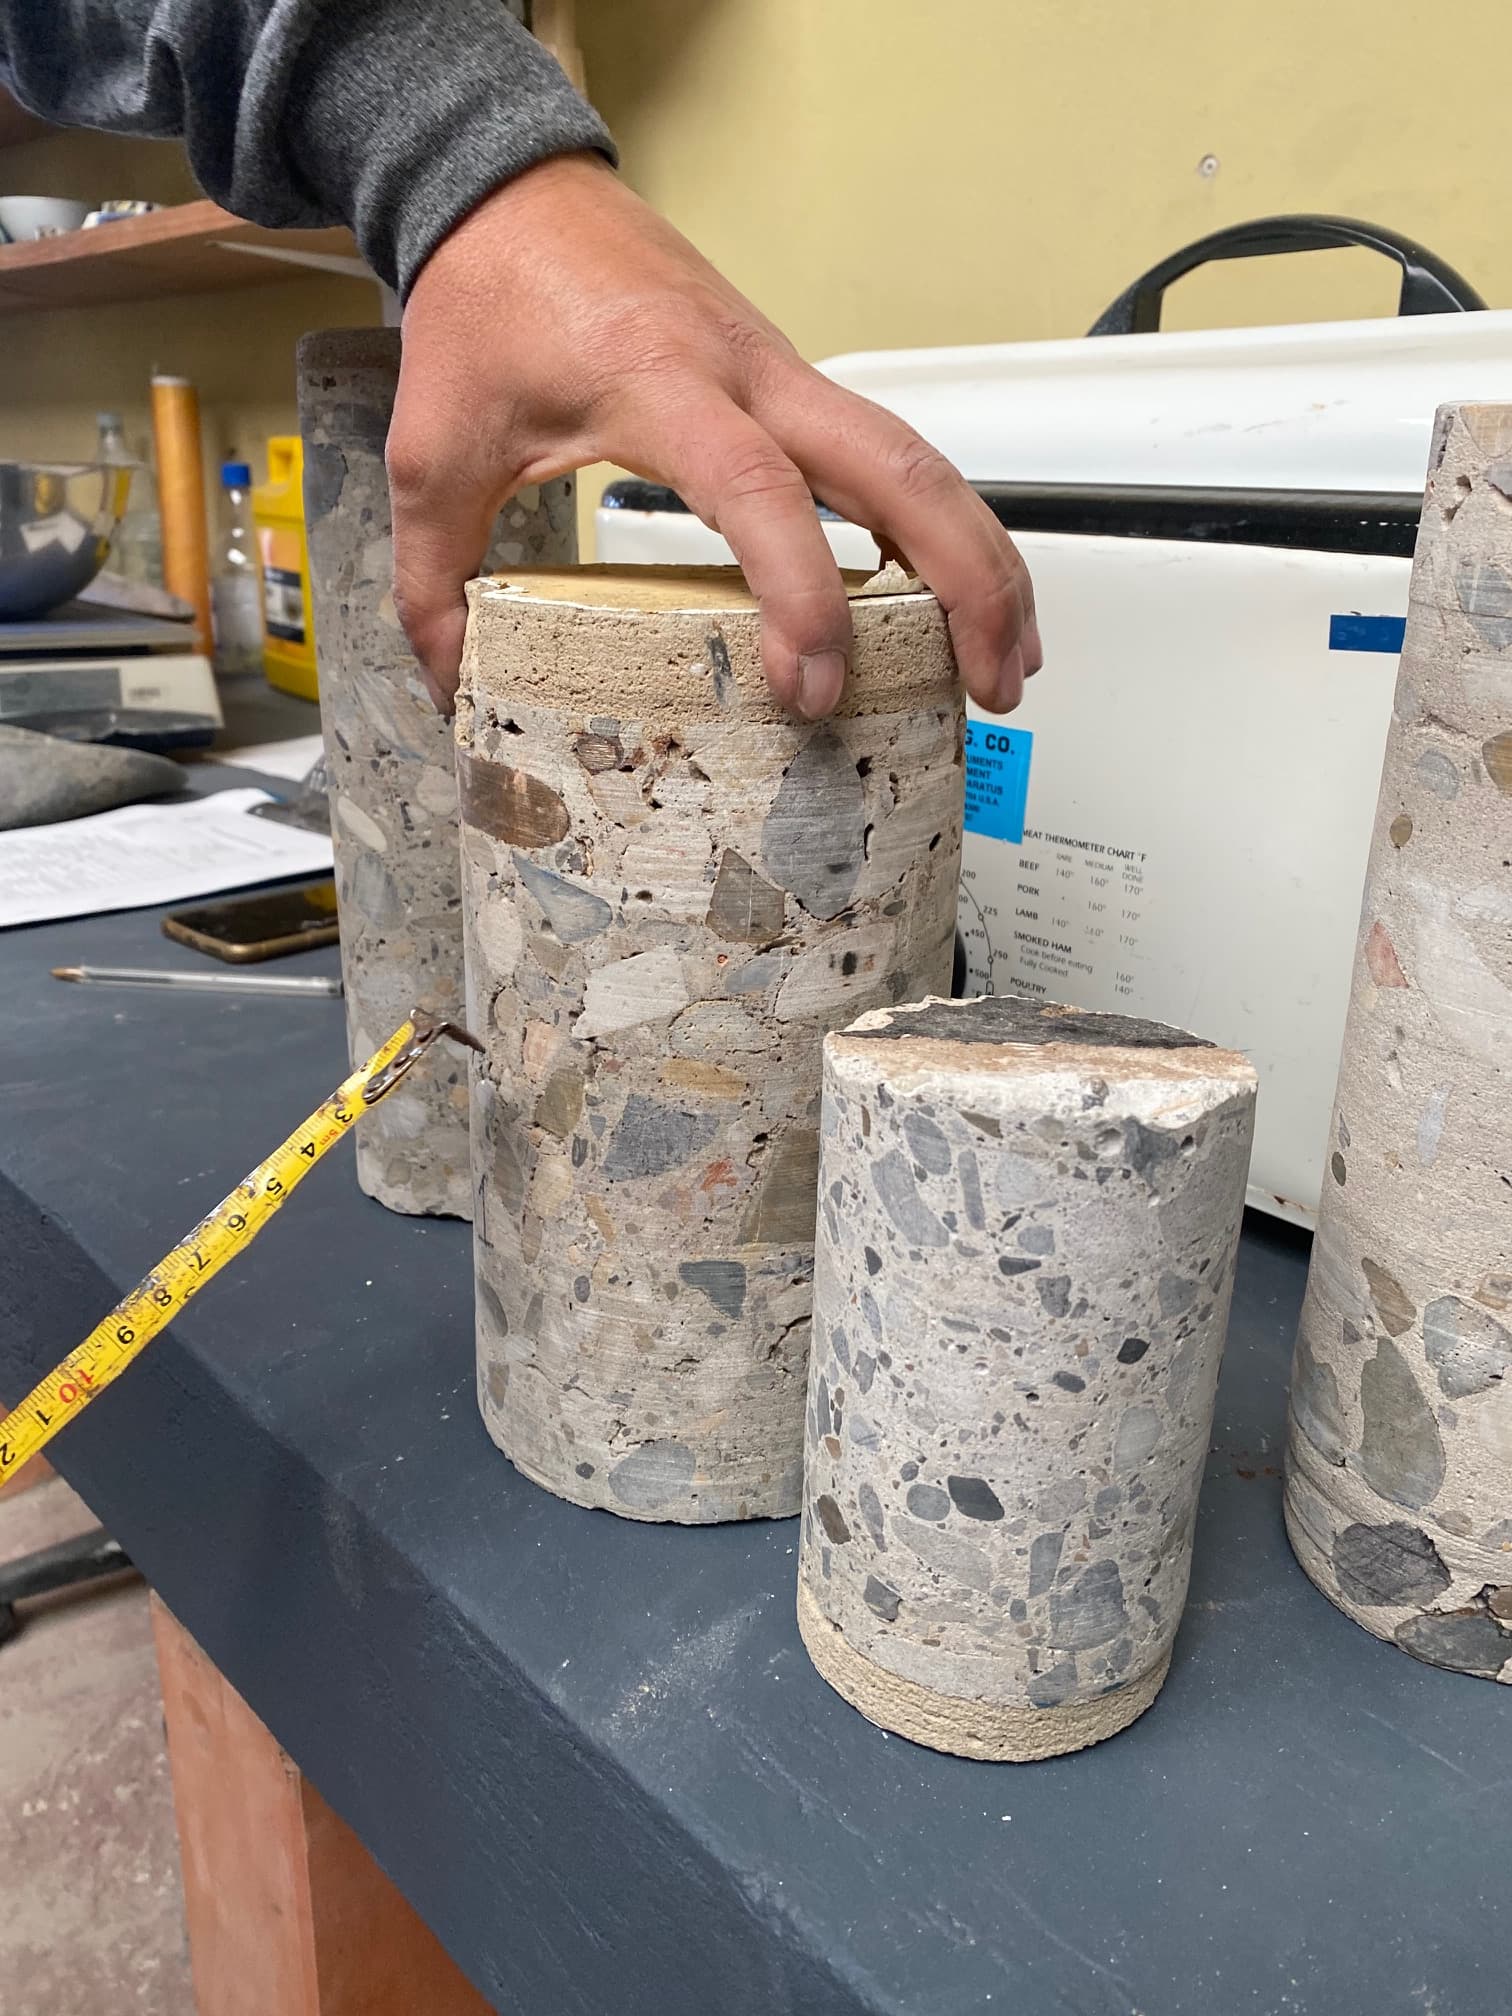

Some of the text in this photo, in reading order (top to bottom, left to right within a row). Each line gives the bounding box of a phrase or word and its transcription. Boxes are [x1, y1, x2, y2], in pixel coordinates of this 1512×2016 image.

[964, 728, 1015, 755] G. CO.
[966, 754, 1004, 771] UMENTS
[966, 767, 991, 780] MENT
[966, 779, 1004, 796] ARATUS
[1023, 829, 1043, 841] MEAT
[1045, 833, 1105, 854] THERMOMETER
[1107, 847, 1135, 861] CHART
[1019, 859, 1040, 872] BEEF
[1084, 859, 1114, 872] MEDIUM
[1125, 863, 1142, 874] WELL
[1122, 872, 1143, 883] DONE
[1017, 883, 1040, 897] PORK
[958, 894, 969, 904] 00
[983, 905, 998, 917] 225
[1015, 907, 1038, 921] LAMB
[970, 928, 985, 939] 450
[1013, 930, 1072, 954] SMOKED HAM
[993, 949, 1008, 961] 250
[1020, 945, 1093, 975] Cook before eating
[974, 968, 990, 980] 500
[1019, 956, 1069, 978] Fully Cooked
[1010, 976, 1047, 995] POULTRY
[335, 1107, 353, 1124] 3
[300, 1142, 316, 1158] 4
[265, 1177, 283, 1195] 5
[227, 1213, 247, 1232] 6
[193, 1250, 212, 1271] 7
[153, 1287, 172, 1307] 8
[116, 1325, 135, 1345] 9
[59, 1368, 95, 1404] 10
